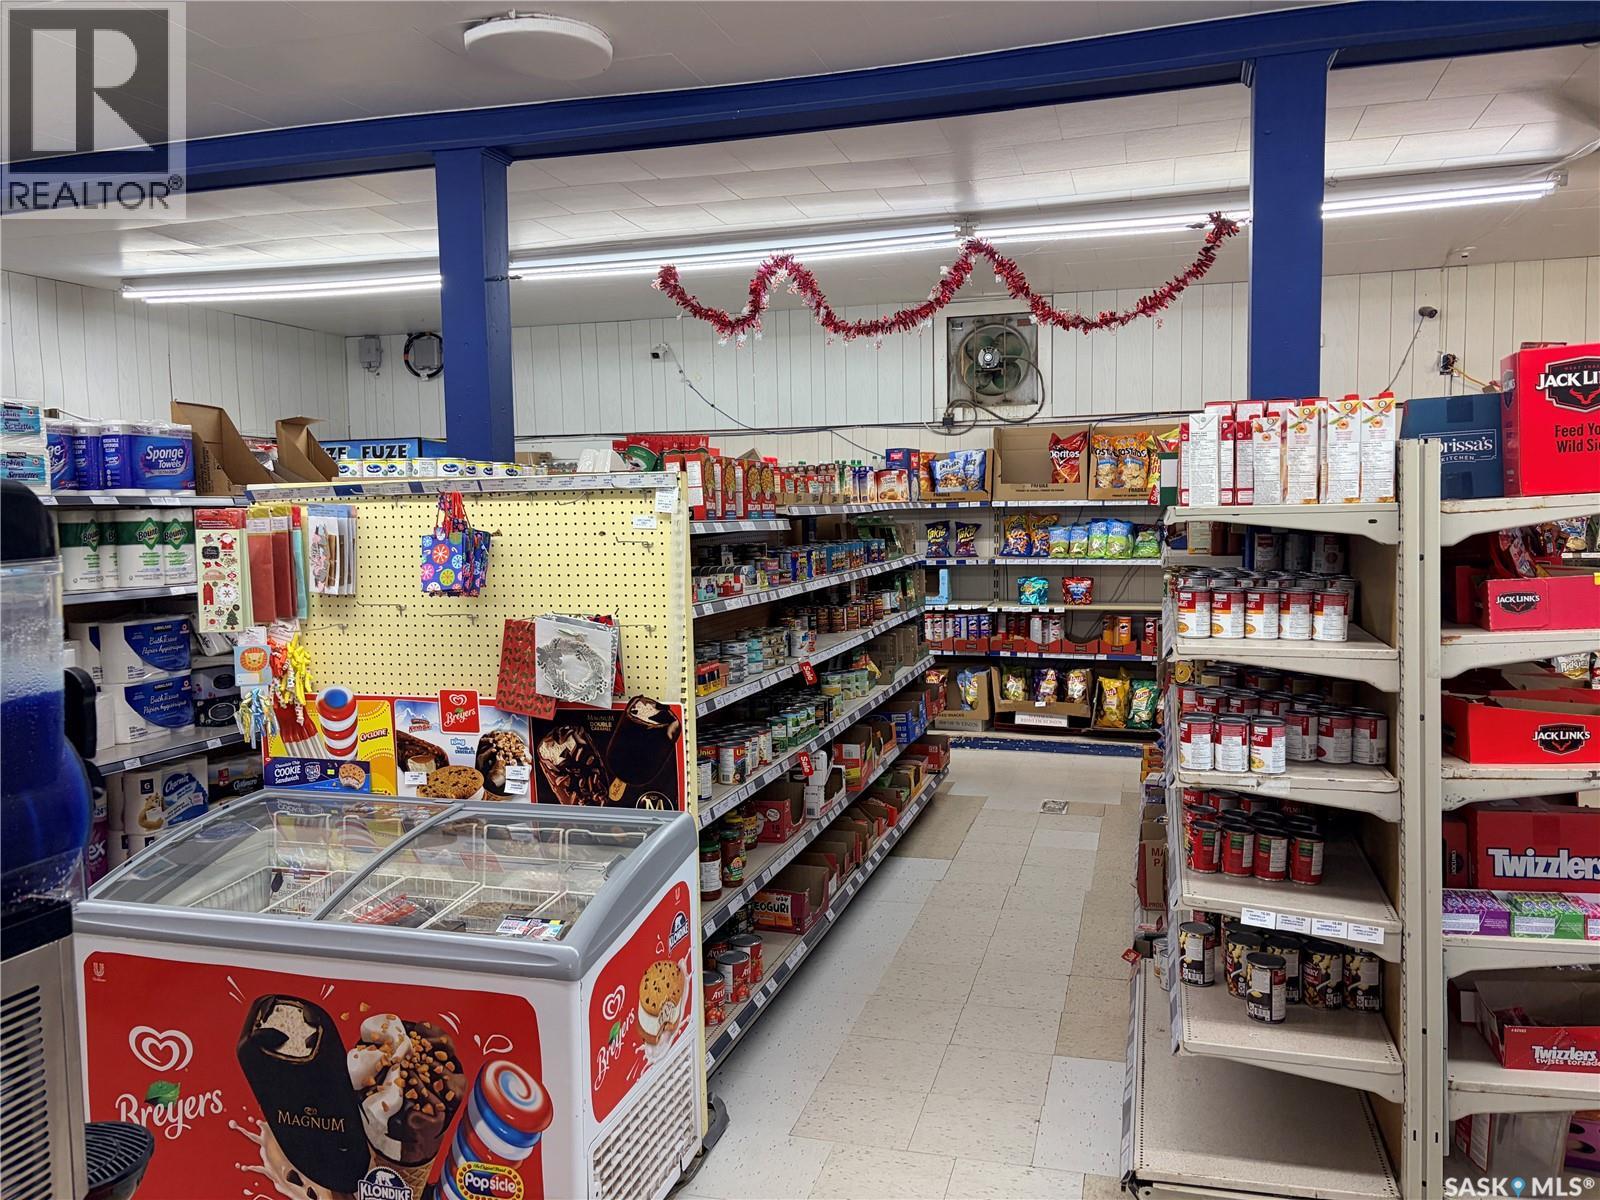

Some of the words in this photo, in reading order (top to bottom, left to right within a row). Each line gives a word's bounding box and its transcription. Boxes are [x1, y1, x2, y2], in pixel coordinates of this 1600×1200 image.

[1536, 372, 1582, 390] JACK
[1555, 423, 1584, 437] Feed
[145, 445, 184, 461] Sponge
[362, 445, 408, 459] FUZE
[1556, 440, 1584, 453] Wild
[158, 459, 182, 469] Towels
[1496, 596, 1516, 604] JACK
[444, 708, 476, 728] Breyers
[1533, 731, 1559, 741] JACK
[275, 765, 301, 777] COOKIE
[800, 756, 810, 773] Sale
[754, 901, 789, 914] EOGURI
[1532, 1046, 1597, 1061] Twizzlers
[115, 1089, 225, 1141] Breyers
[278, 1109, 345, 1133] MAGNUM
[464, 1171, 517, 1193] Popsicle
[360, 1182, 412, 1200] KLONDIKE
